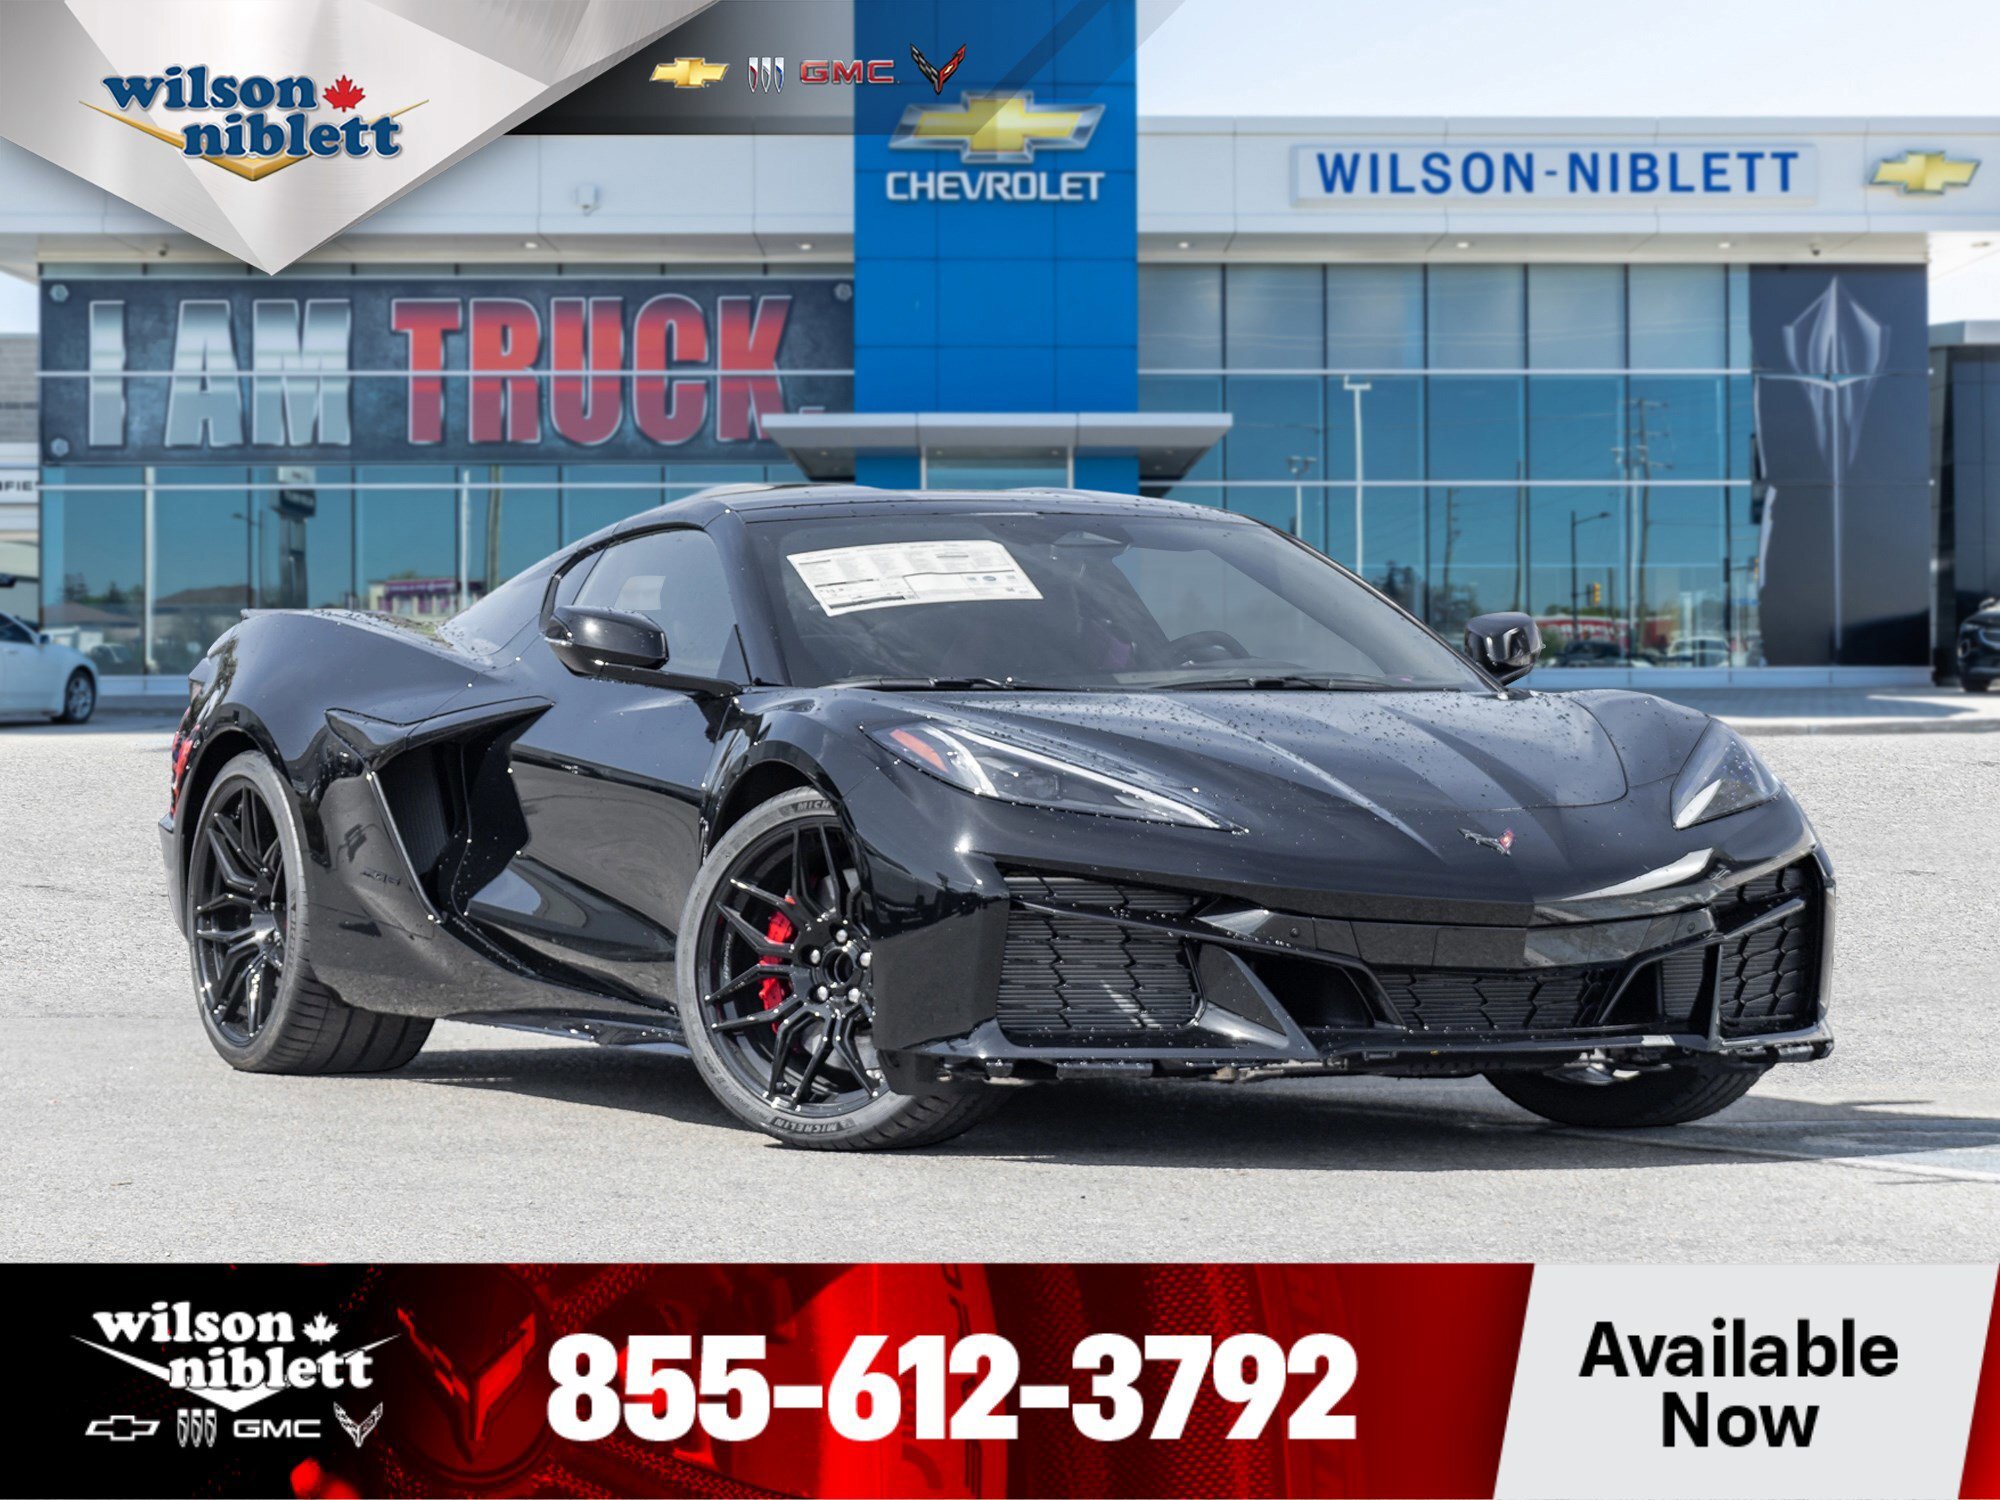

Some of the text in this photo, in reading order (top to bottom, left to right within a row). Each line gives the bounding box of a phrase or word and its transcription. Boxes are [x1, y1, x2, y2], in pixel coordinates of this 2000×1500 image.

[886, 171, 1104, 202] CHEVROLET
[1317, 151, 1799, 194] WILSON-NIBLETT
[88, 293, 824, 447] I AM TRUCK
[773, 1117, 839, 1134] MICHELIN
